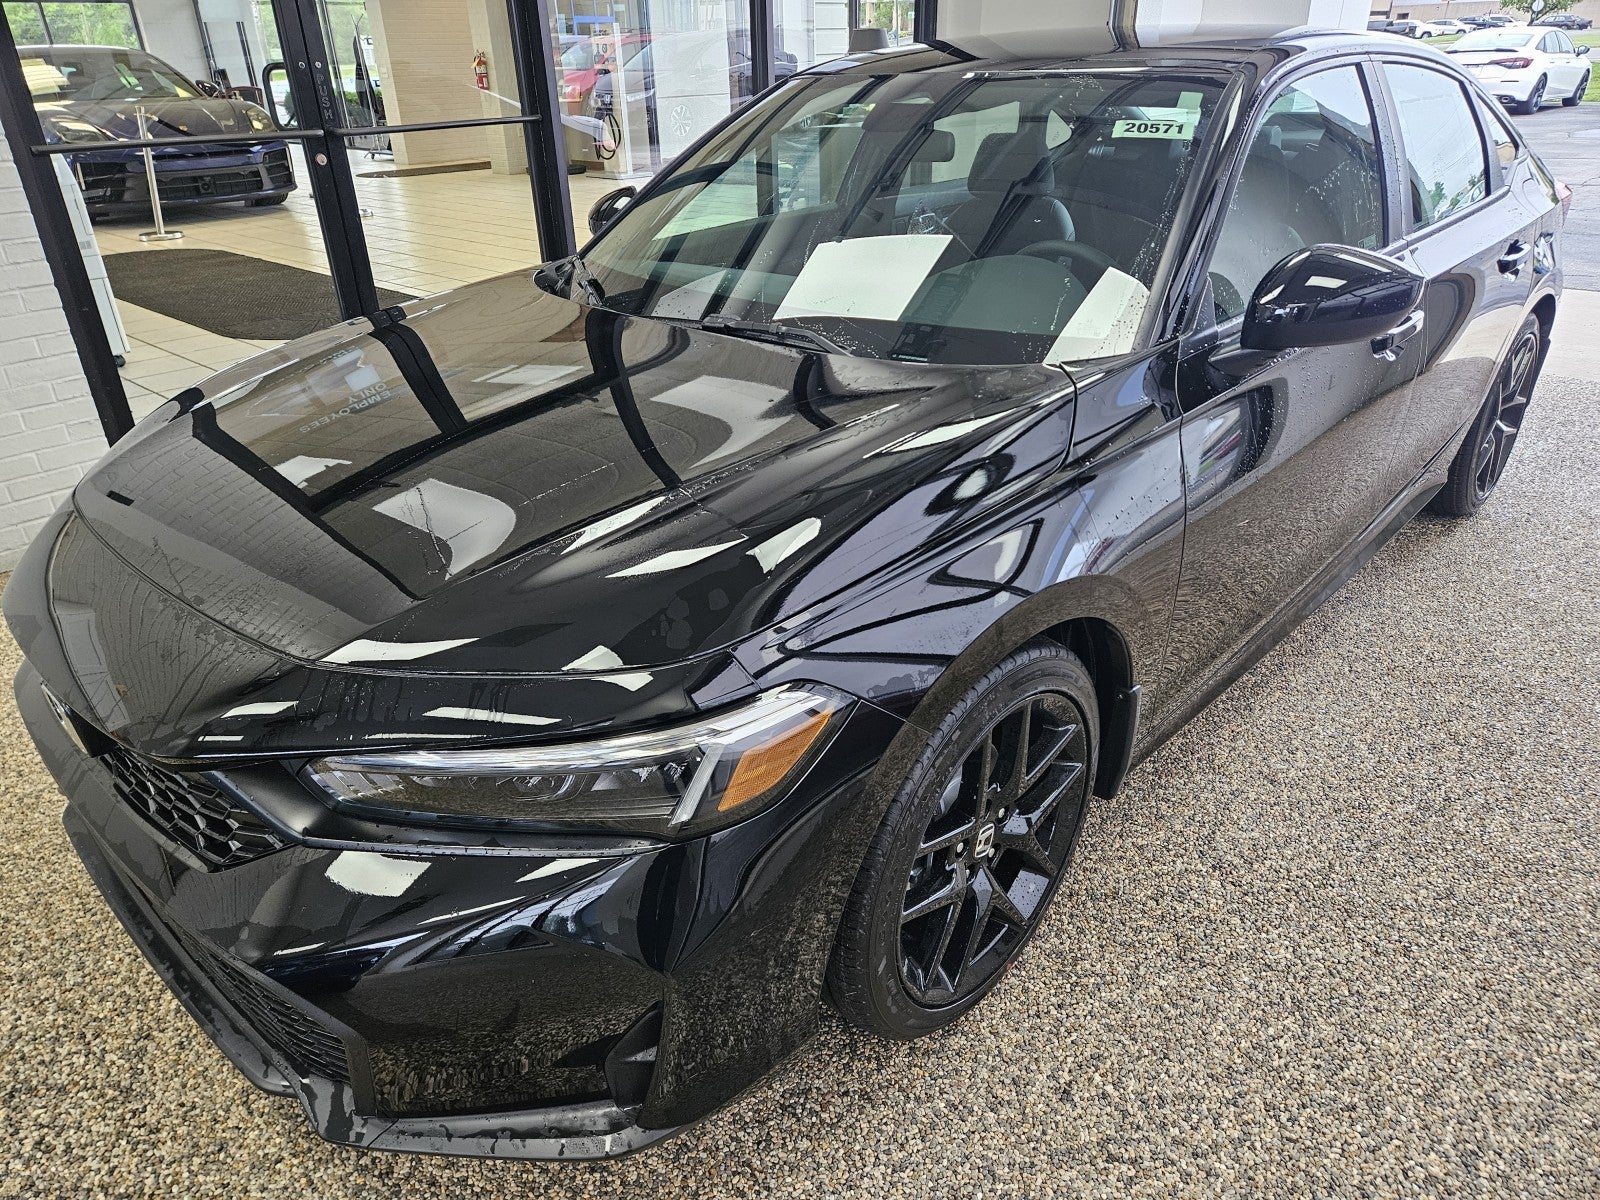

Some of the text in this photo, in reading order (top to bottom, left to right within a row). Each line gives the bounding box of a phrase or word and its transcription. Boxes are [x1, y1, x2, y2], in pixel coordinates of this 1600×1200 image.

[316, 73, 333, 120] PUSH
[1123, 122, 1185, 134] 20571
[348, 382, 387, 404] ONLY
[299, 390, 391, 433] EMPLOYEES
